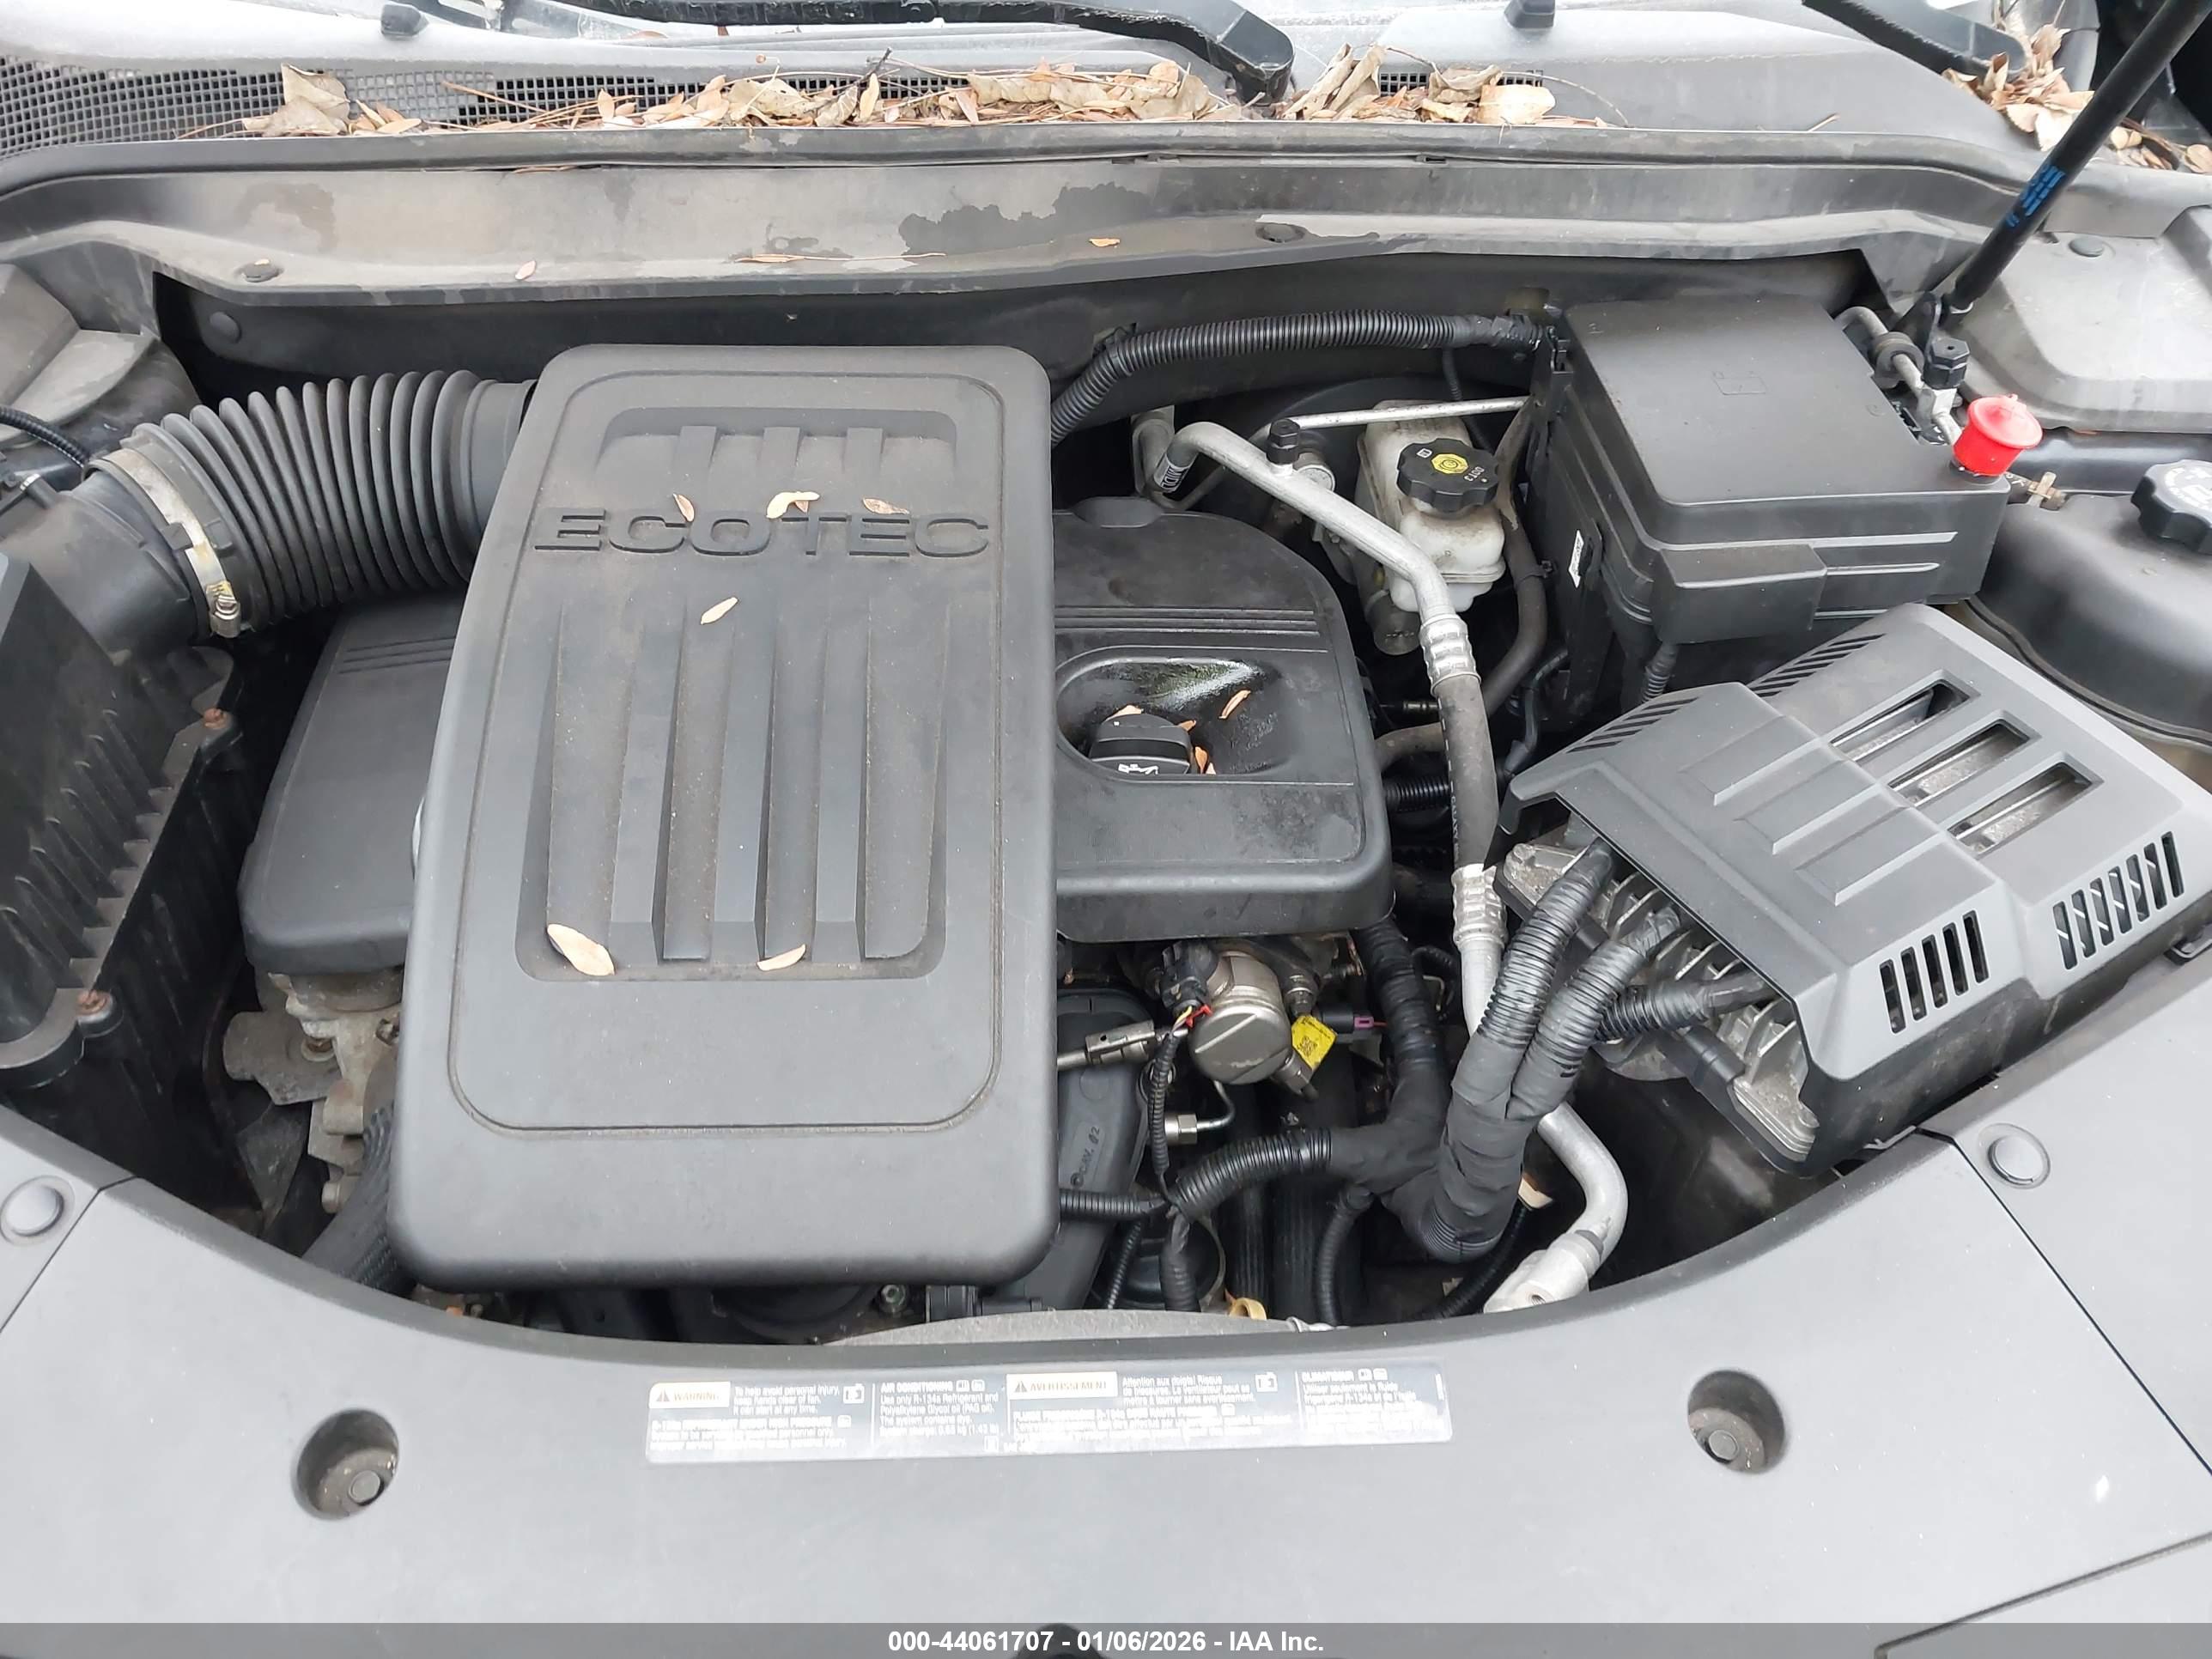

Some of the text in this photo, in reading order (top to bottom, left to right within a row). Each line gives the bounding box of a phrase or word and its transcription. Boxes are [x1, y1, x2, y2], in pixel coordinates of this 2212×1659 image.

[534, 507, 988, 558] ECOTEC
[881, 1381, 953, 1393] AIR CONDITIONING
[1030, 1381, 1106, 1391] AVERTISSEMENT
[1123, 1376, 1154, 1387] Attention
[674, 1392, 721, 1401] WARNING
[735, 1387, 744, 1396] To
[744, 1387, 761, 1398] help
[763, 1385, 782, 1395] avoid
[784, 1384, 816, 1398] personal
[755, 1395, 777, 1406] hands
[778, 1395, 797, 1405] clear
[799, 1395, 806, 1405] of
[880, 1391, 999, 1406] Use only R-134a Refrigerant and
[880, 1405, 926, 1416] Polyalkylene
[927, 1403, 950, 1416] Glycol
[951, 1403, 961, 1413] oil
[962, 1402, 979, 1415] (PAG
[880, 1416, 894, 1426] The
[924, 1415, 955, 1425] contains
